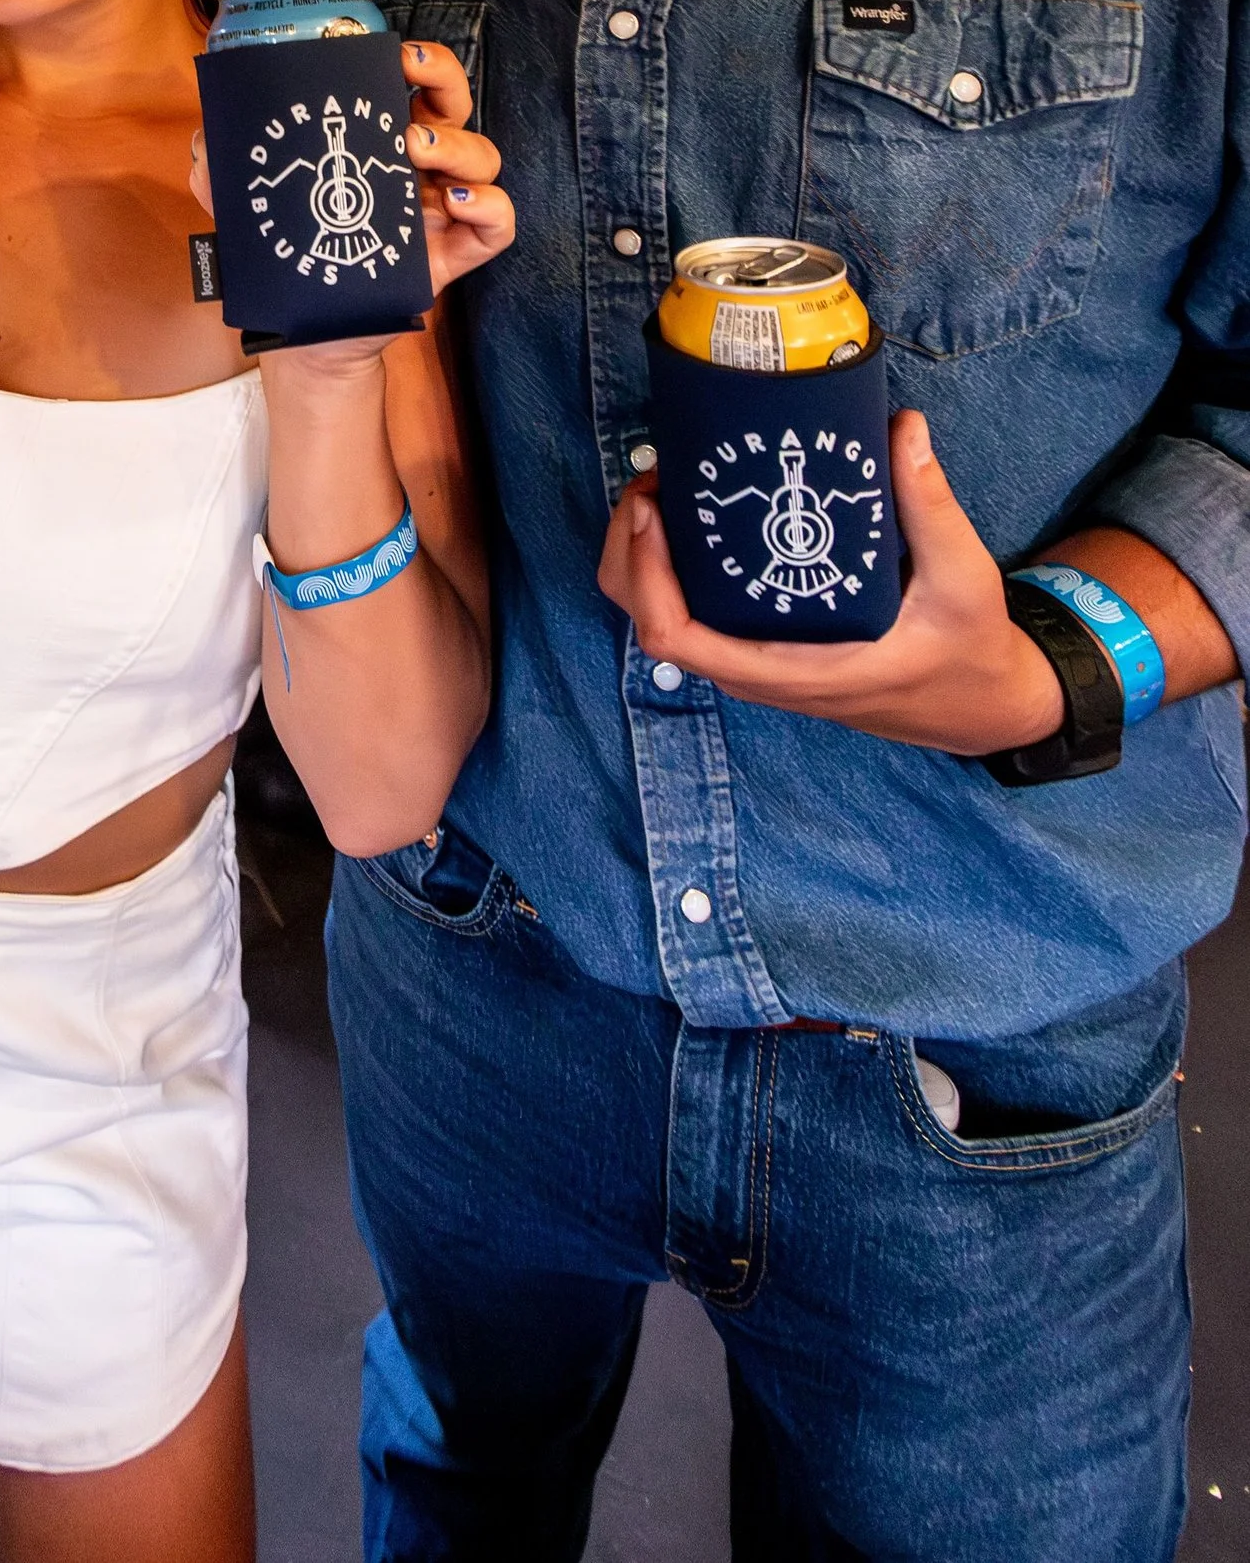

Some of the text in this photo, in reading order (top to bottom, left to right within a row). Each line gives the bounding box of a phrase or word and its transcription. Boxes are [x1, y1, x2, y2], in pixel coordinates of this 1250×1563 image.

[850, 5, 908, 24] Wrangler
[250, 95, 405, 166] DURANGO
[251, 180, 415, 286] BLUES TRAIN
[199, 247, 214, 296] koozie
[698, 428, 877, 482] DURANGO
[697, 501, 884, 614] BLUES TRAIN
